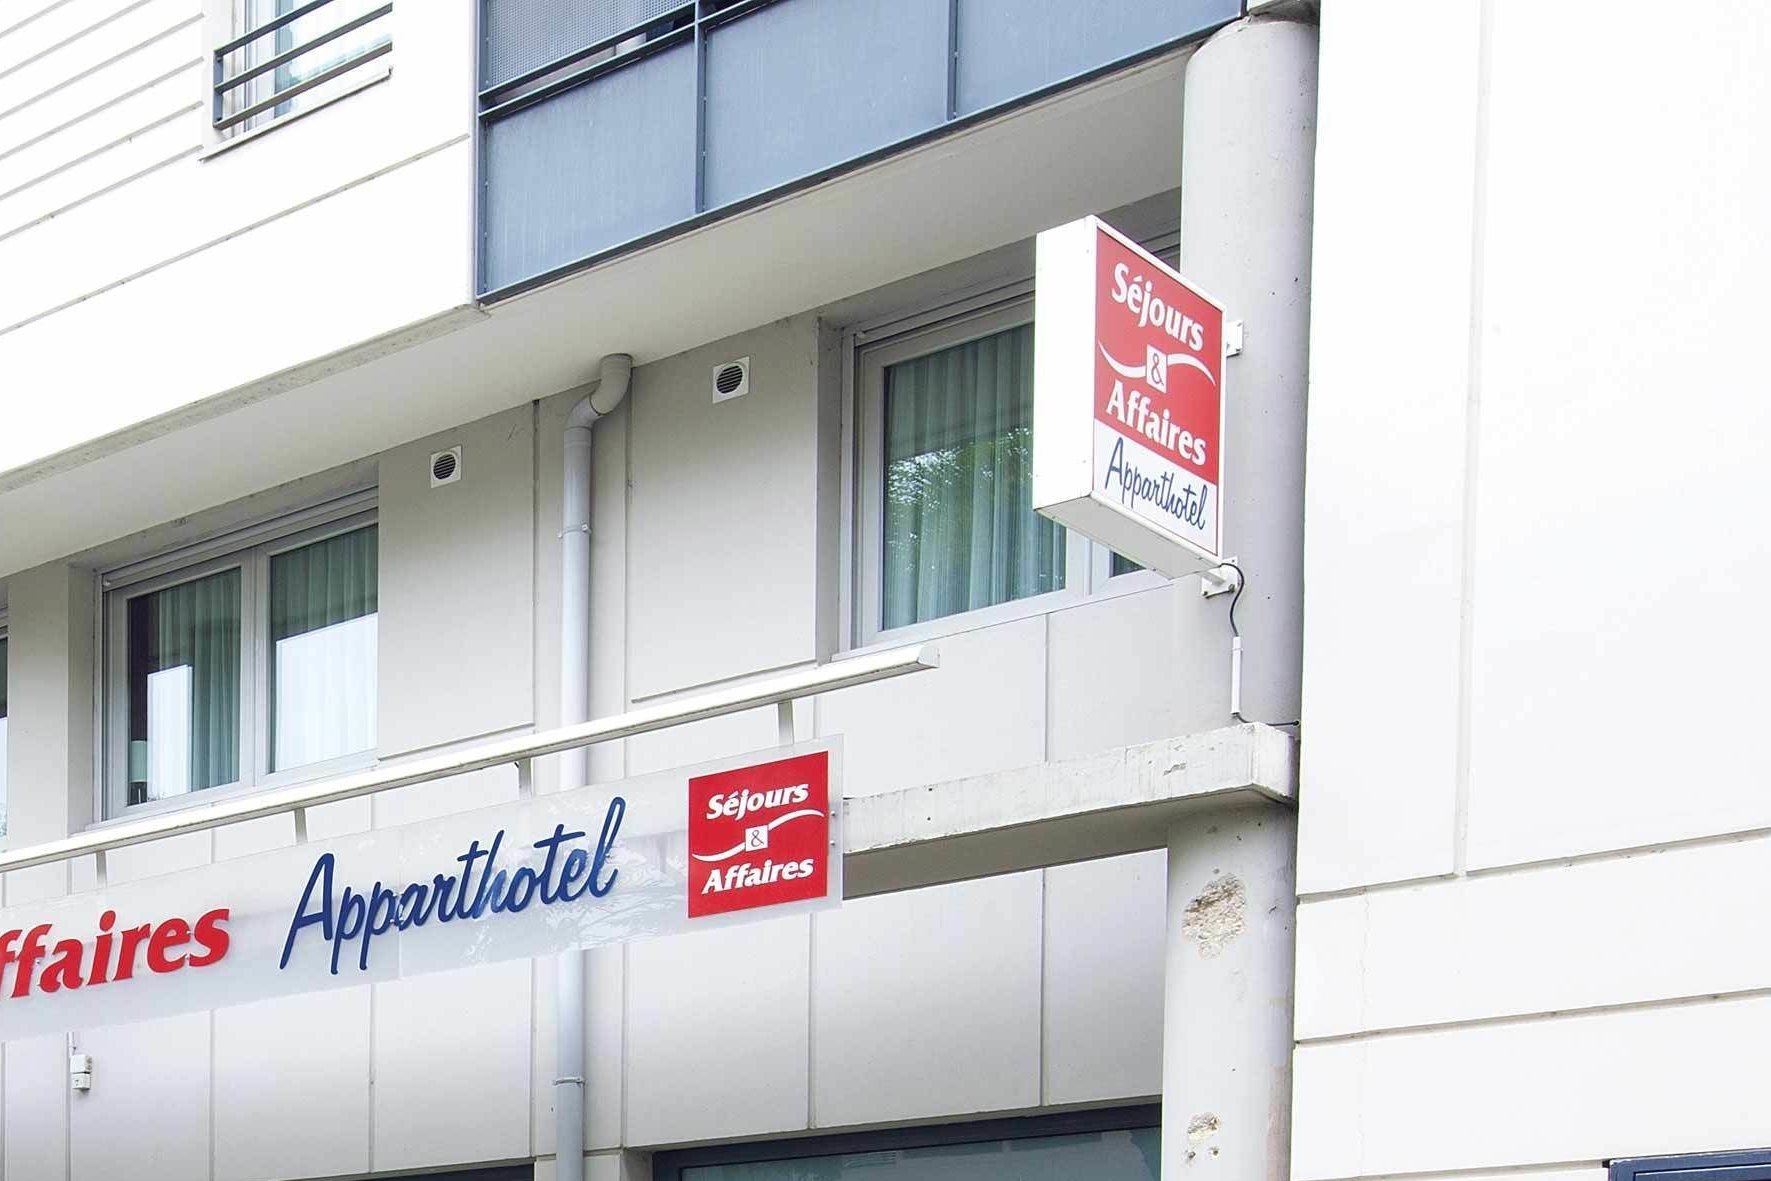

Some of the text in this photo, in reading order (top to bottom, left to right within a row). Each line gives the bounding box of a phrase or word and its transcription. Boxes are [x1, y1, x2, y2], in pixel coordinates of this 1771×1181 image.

[1110, 262, 1205, 352] Séjours
[1150, 352, 1165, 387] &
[1104, 378, 1208, 467] Affaires
[1104, 436, 1209, 531] Apparthotel
[705, 783, 809, 822] Séjours
[750, 829, 765, 848] &
[280, 797, 627, 975] Apparthotel
[700, 858, 814, 895] Affaires
